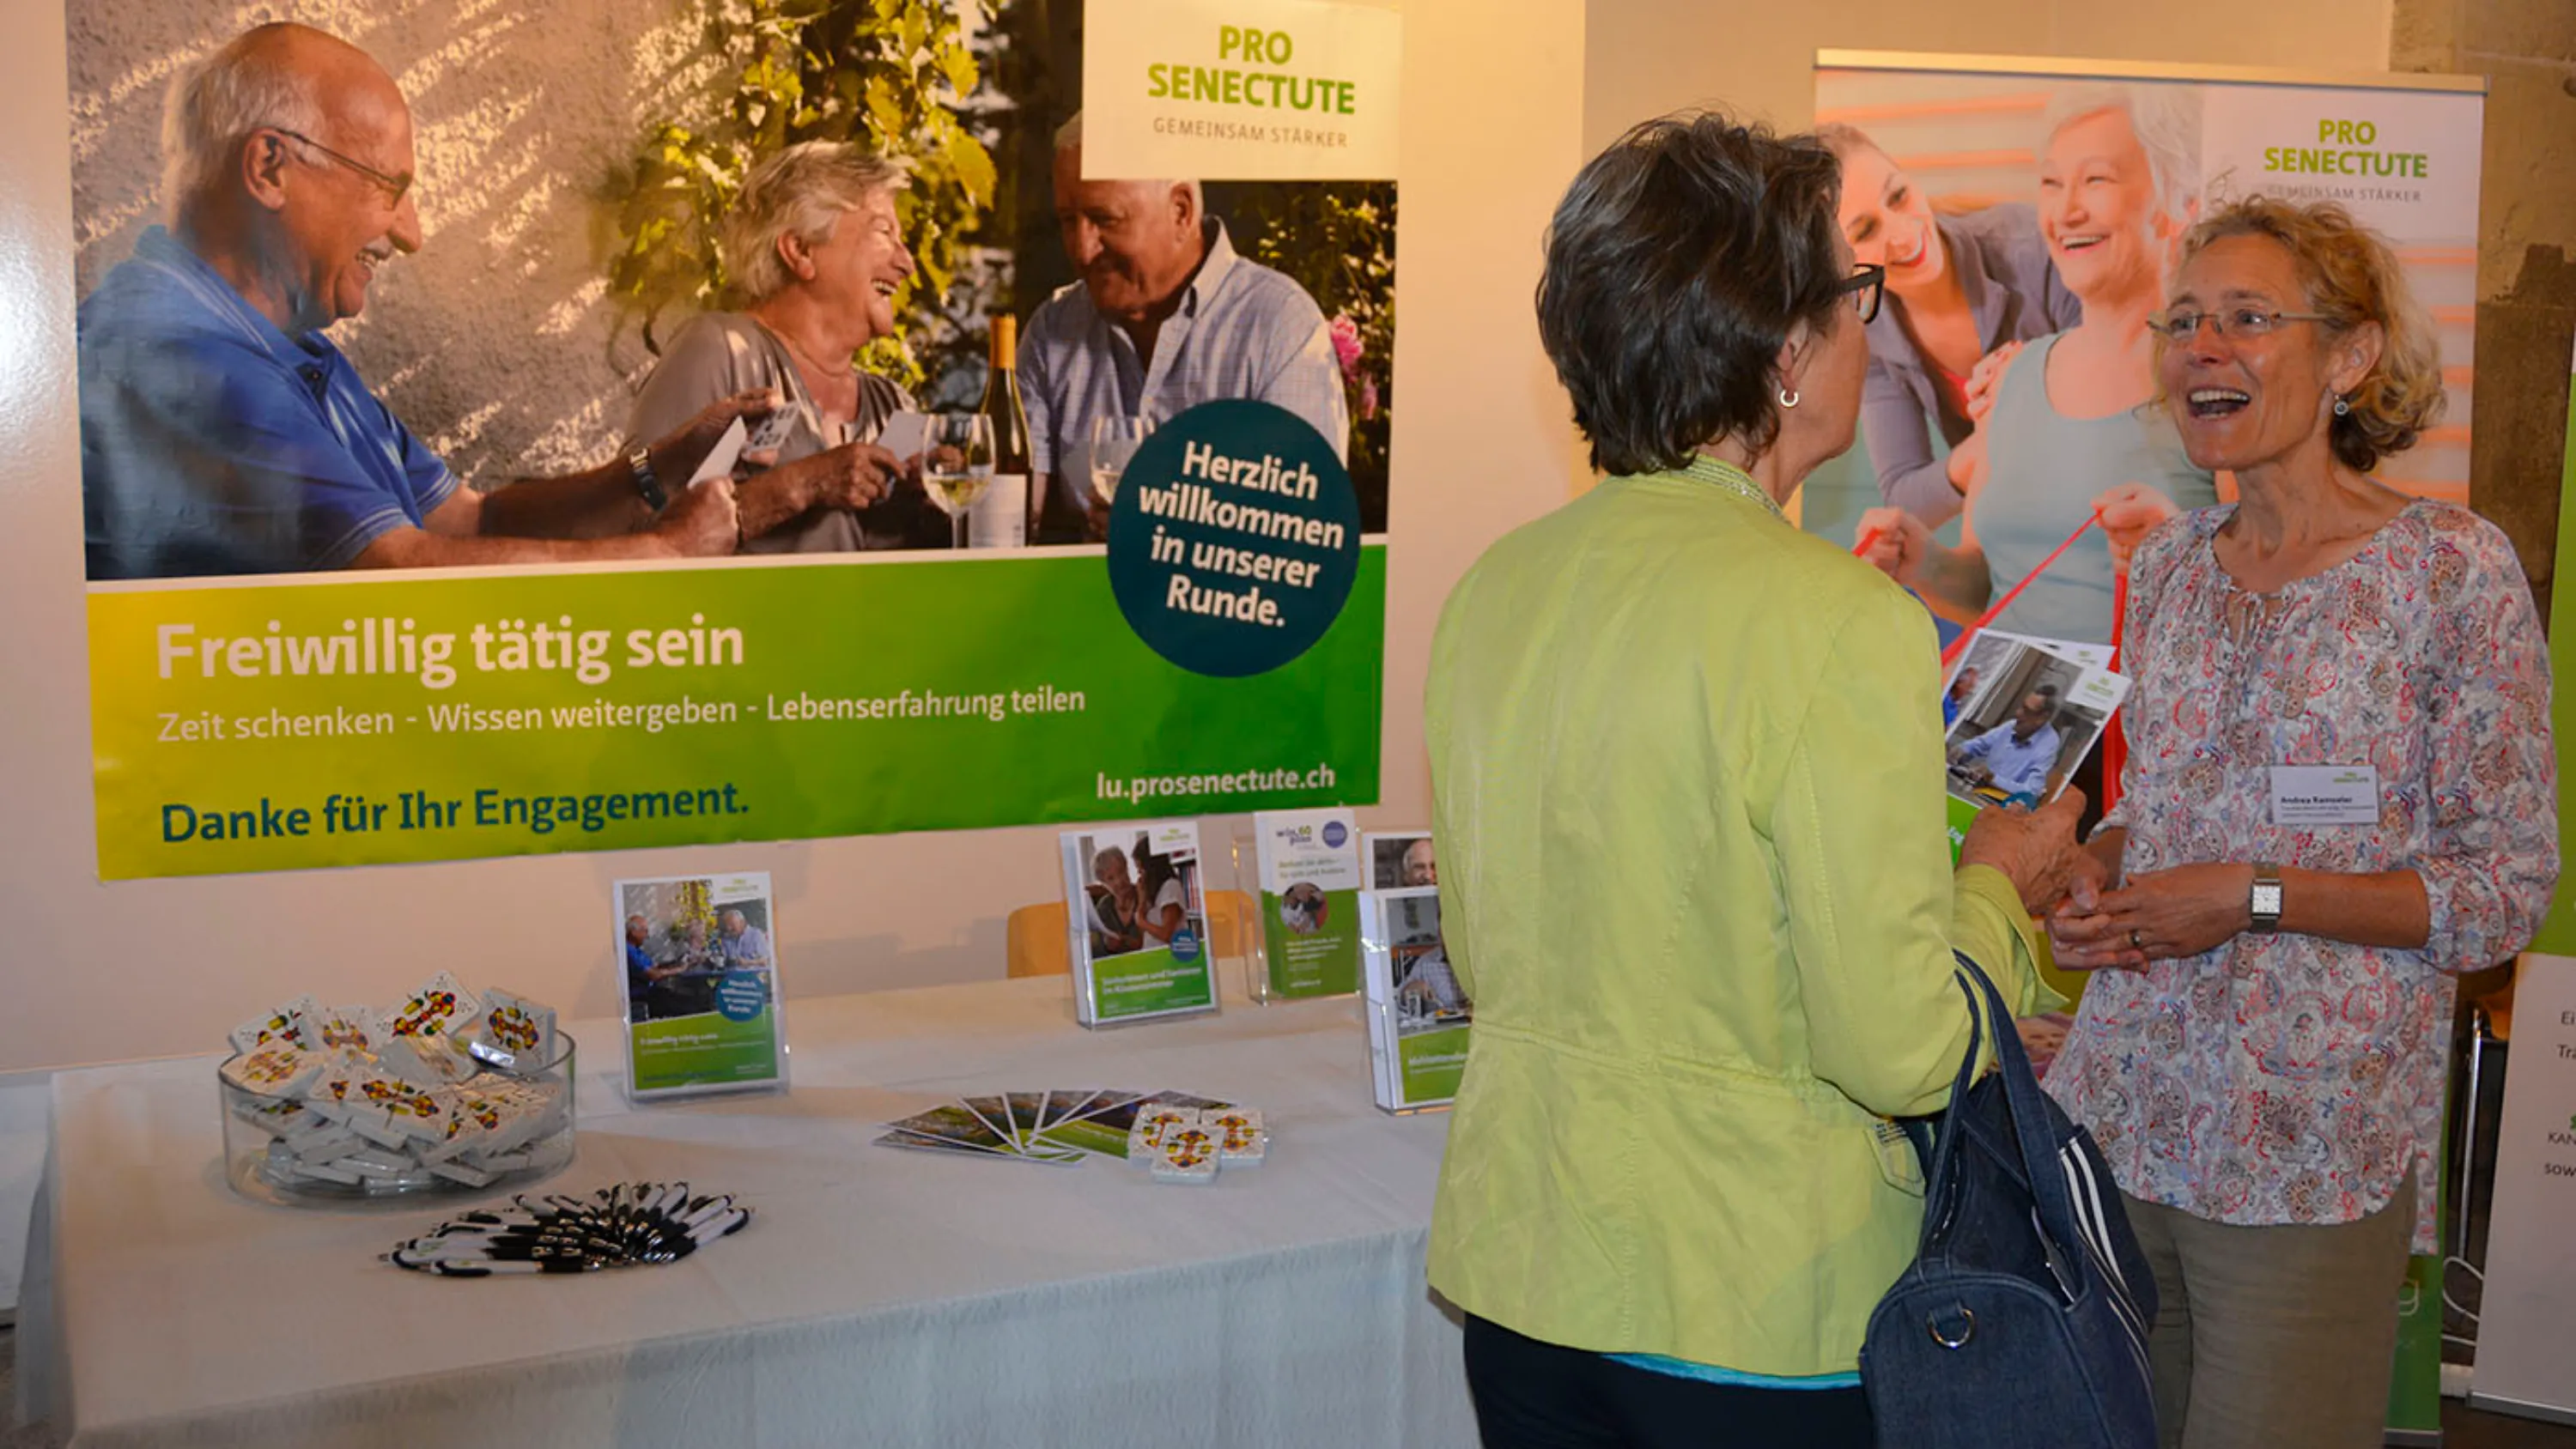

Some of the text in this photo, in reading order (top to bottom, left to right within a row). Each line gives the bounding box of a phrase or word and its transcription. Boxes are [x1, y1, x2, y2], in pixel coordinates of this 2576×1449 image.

[1218, 25, 1292, 65] PRO
[1147, 63, 1356, 115] SENECTUTE
[1153, 117, 1265, 142] GEMEINSAM
[2318, 119, 2376, 145] PRO
[2264, 147, 2428, 179] SENECTUTE
[1182, 440, 1319, 501] Herzlich
[1139, 483, 1345, 550] willkommen
[1151, 530, 1321, 591] in unserer
[1166, 573, 1286, 628] Runde.
[156, 613, 744, 689] Freiwillig tätig sein
[157, 710, 225, 743] Zeit
[234, 705, 394, 740] schenken
[428, 701, 544, 733] Wissen
[551, 697, 737, 733] weitergeben
[767, 689, 1005, 723] Lebenserfahrung
[1012, 686, 1085, 713] teilen
[161, 780, 750, 844] Danke für Ihr Engagement.
[1096, 763, 1335, 806] lu.prosenectute.ch
